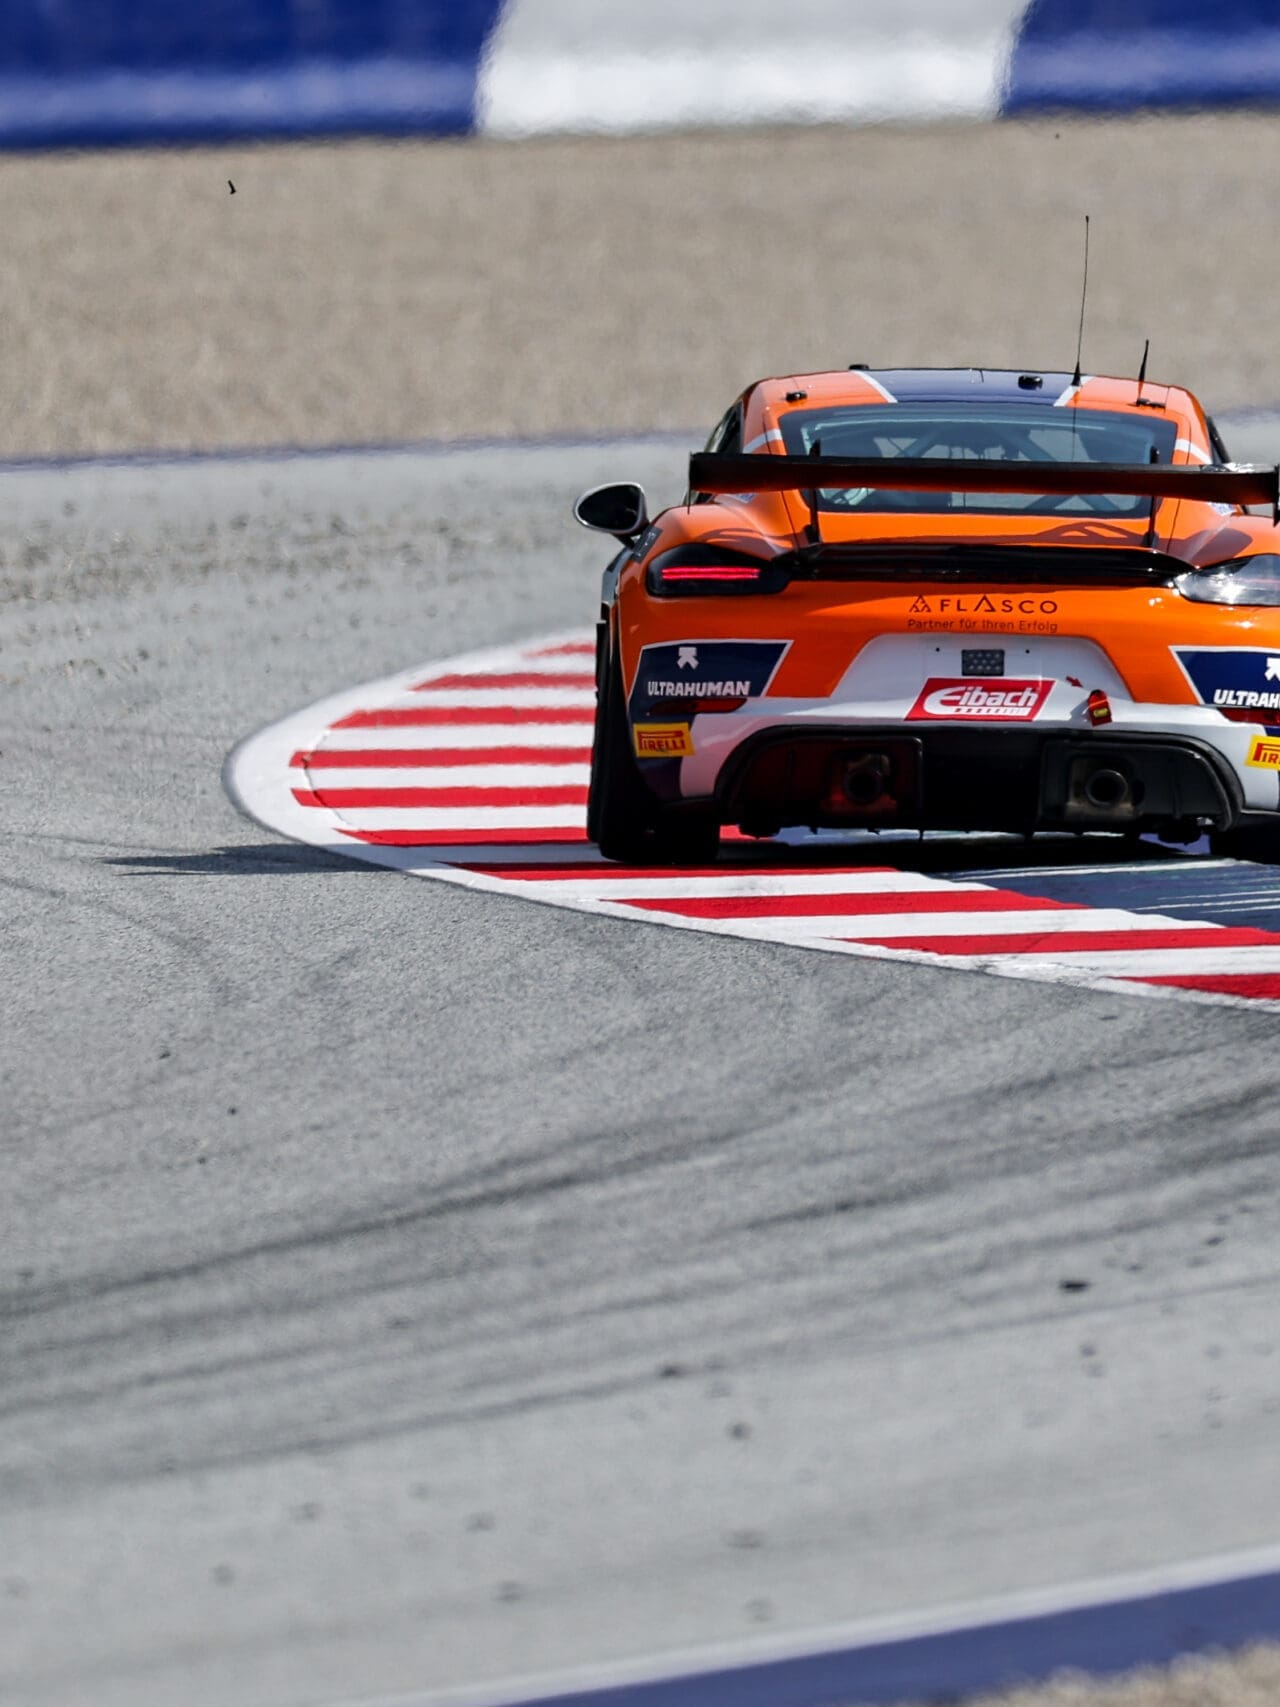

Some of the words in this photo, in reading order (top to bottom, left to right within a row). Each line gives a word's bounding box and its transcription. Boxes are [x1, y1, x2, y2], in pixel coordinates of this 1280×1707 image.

[907, 618, 955, 629] Partner
[959, 618, 977, 629] für
[982, 619, 1014, 630] Ihren
[1019, 620, 1058, 633] Erfolg
[648, 681, 750, 696] ULTRAHUMAN
[923, 686, 1039, 716] Eibach
[637, 730, 686, 751] PIRELLI
